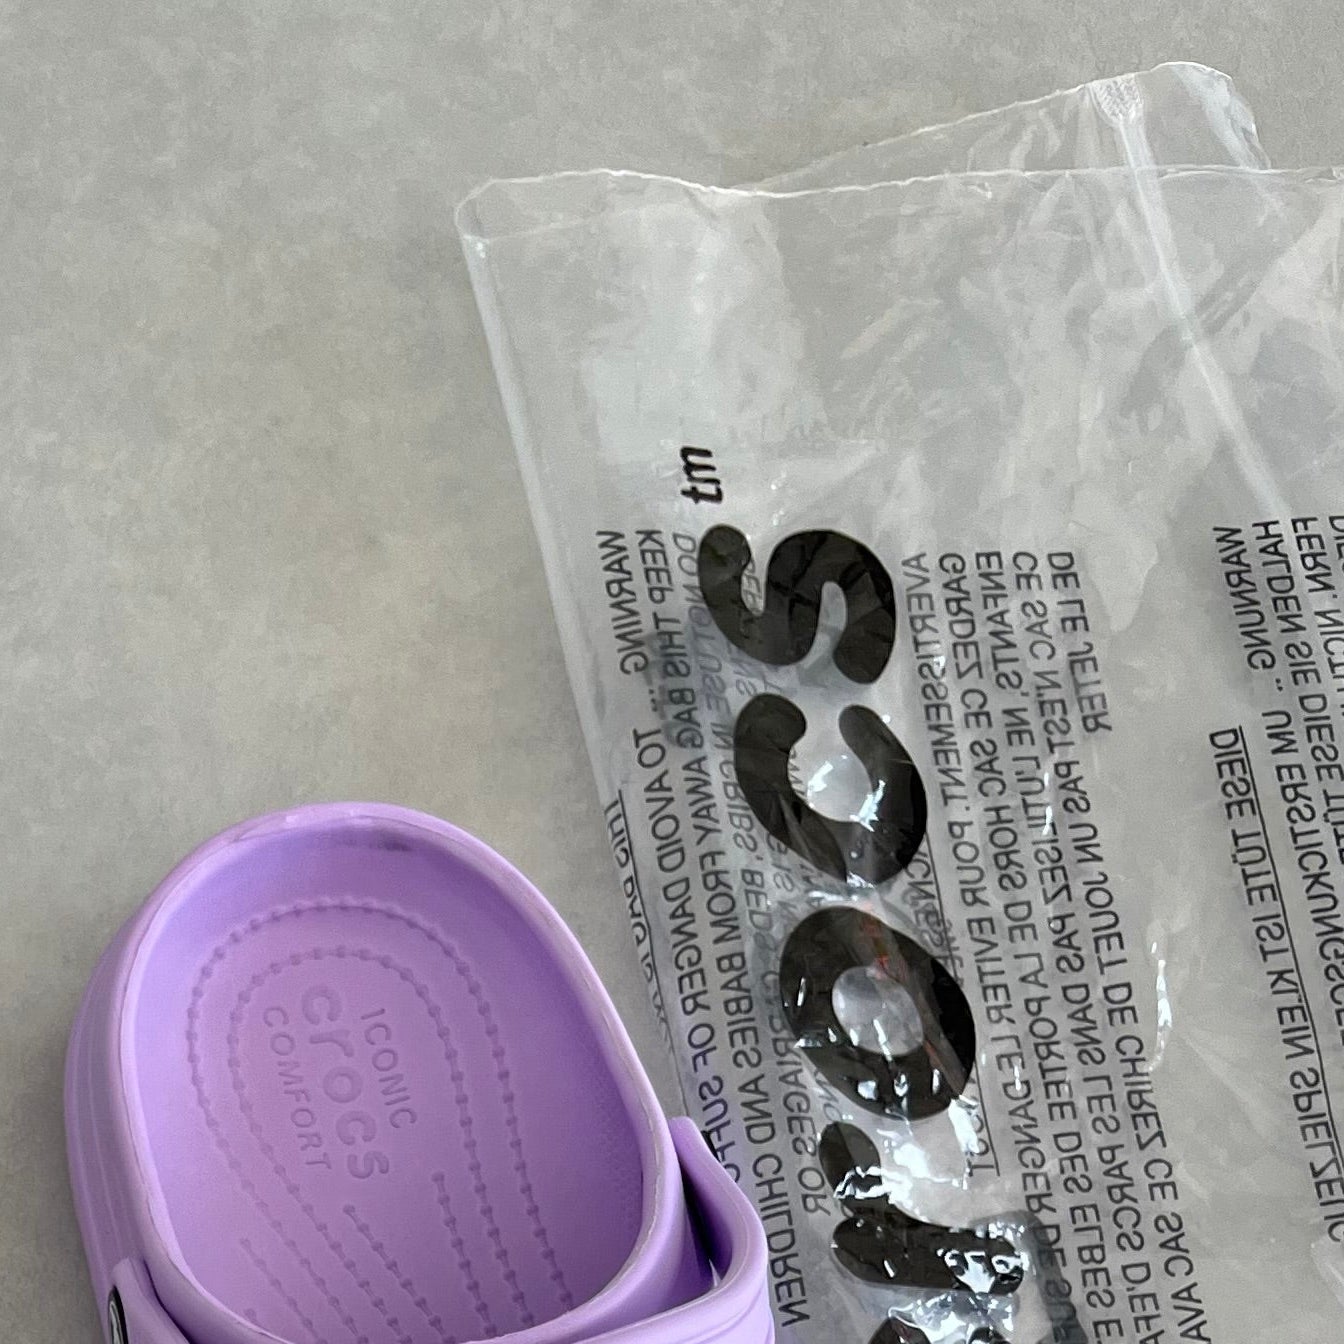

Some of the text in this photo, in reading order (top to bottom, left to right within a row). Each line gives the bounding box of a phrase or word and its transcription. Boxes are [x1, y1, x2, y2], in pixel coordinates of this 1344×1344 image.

[263, 1006, 332, 1169] COMFORT
[302, 985, 390, 1179] crocs
[360, 1008, 418, 1128] ICONIC
